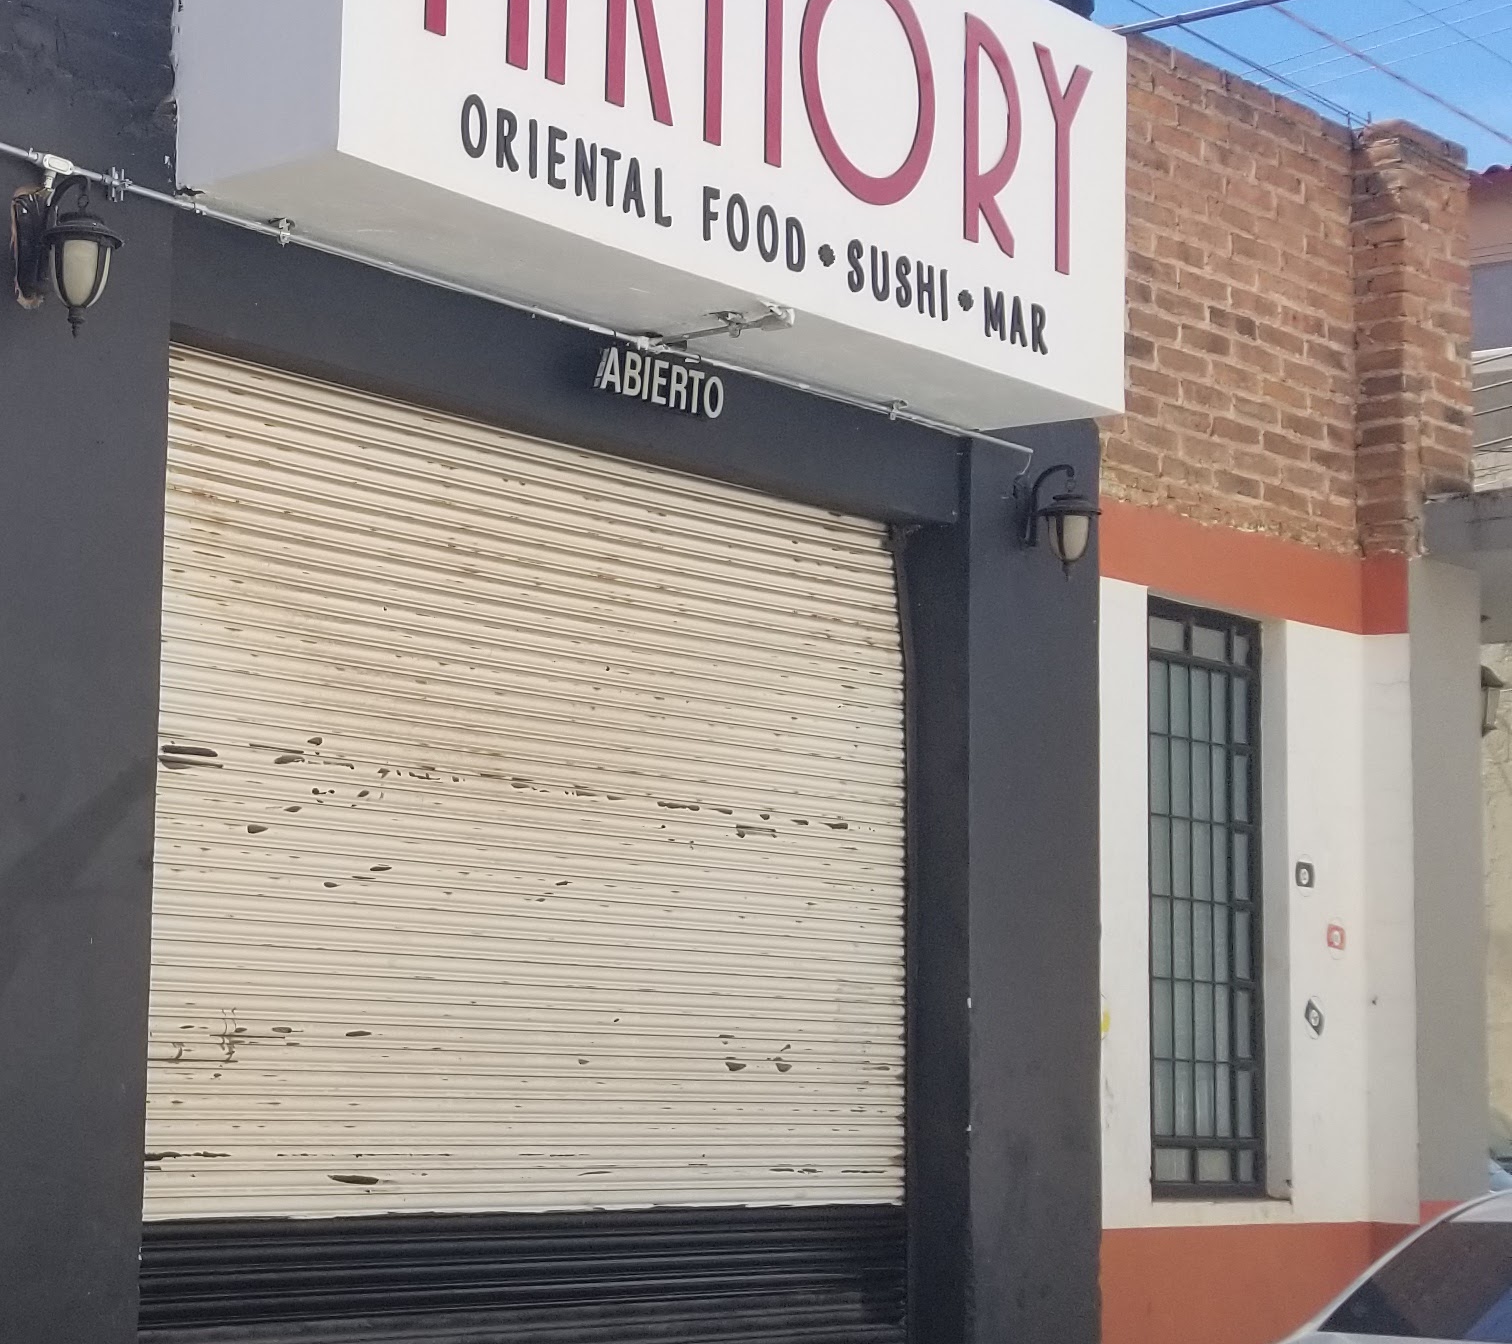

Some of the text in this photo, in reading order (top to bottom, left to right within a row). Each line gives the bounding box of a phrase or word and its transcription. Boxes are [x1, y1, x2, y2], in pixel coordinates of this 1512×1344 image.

[461, 94, 1049, 356] ORIENTAL FOOD SUSHI MAR
[596, 346, 724, 419] ABIERTO
